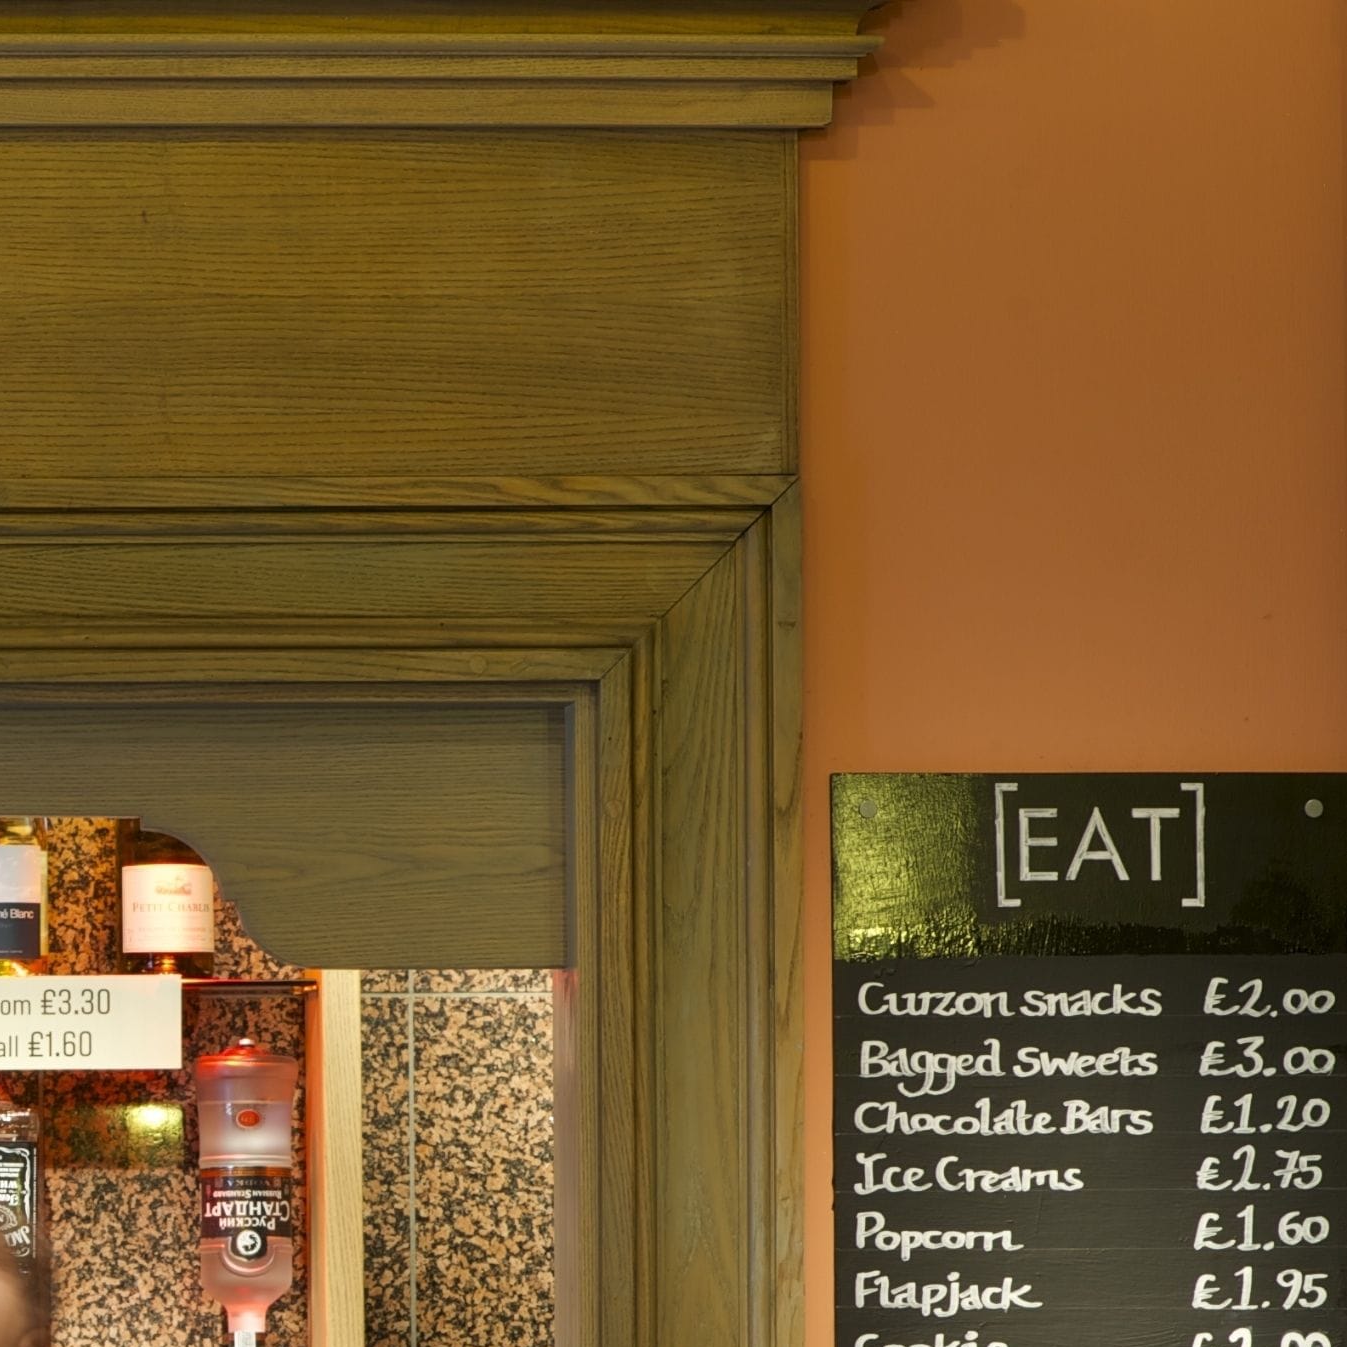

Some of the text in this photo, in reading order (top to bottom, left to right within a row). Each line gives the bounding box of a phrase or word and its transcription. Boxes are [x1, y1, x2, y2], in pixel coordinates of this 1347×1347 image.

[10, 910, 33, 918] Blanc
[40, 989, 111, 1015] £3.30
[858, 982, 1015, 1018] Curzon
[1204, 978, 1336, 1018] £2.00
[28, 1031, 92, 1057] £1.60
[859, 1039, 1005, 1097] Bagged
[1199, 1036, 1336, 1077] £3.00
[854, 1093, 1331, 1136] Chocolate Bars £1.20
[854, 1145, 1323, 1195] Ice Creams £2.75
[855, 1205, 1329, 1261] Popcorn £1.60
[855, 1266, 1329, 1317] Flapjack £1.95
